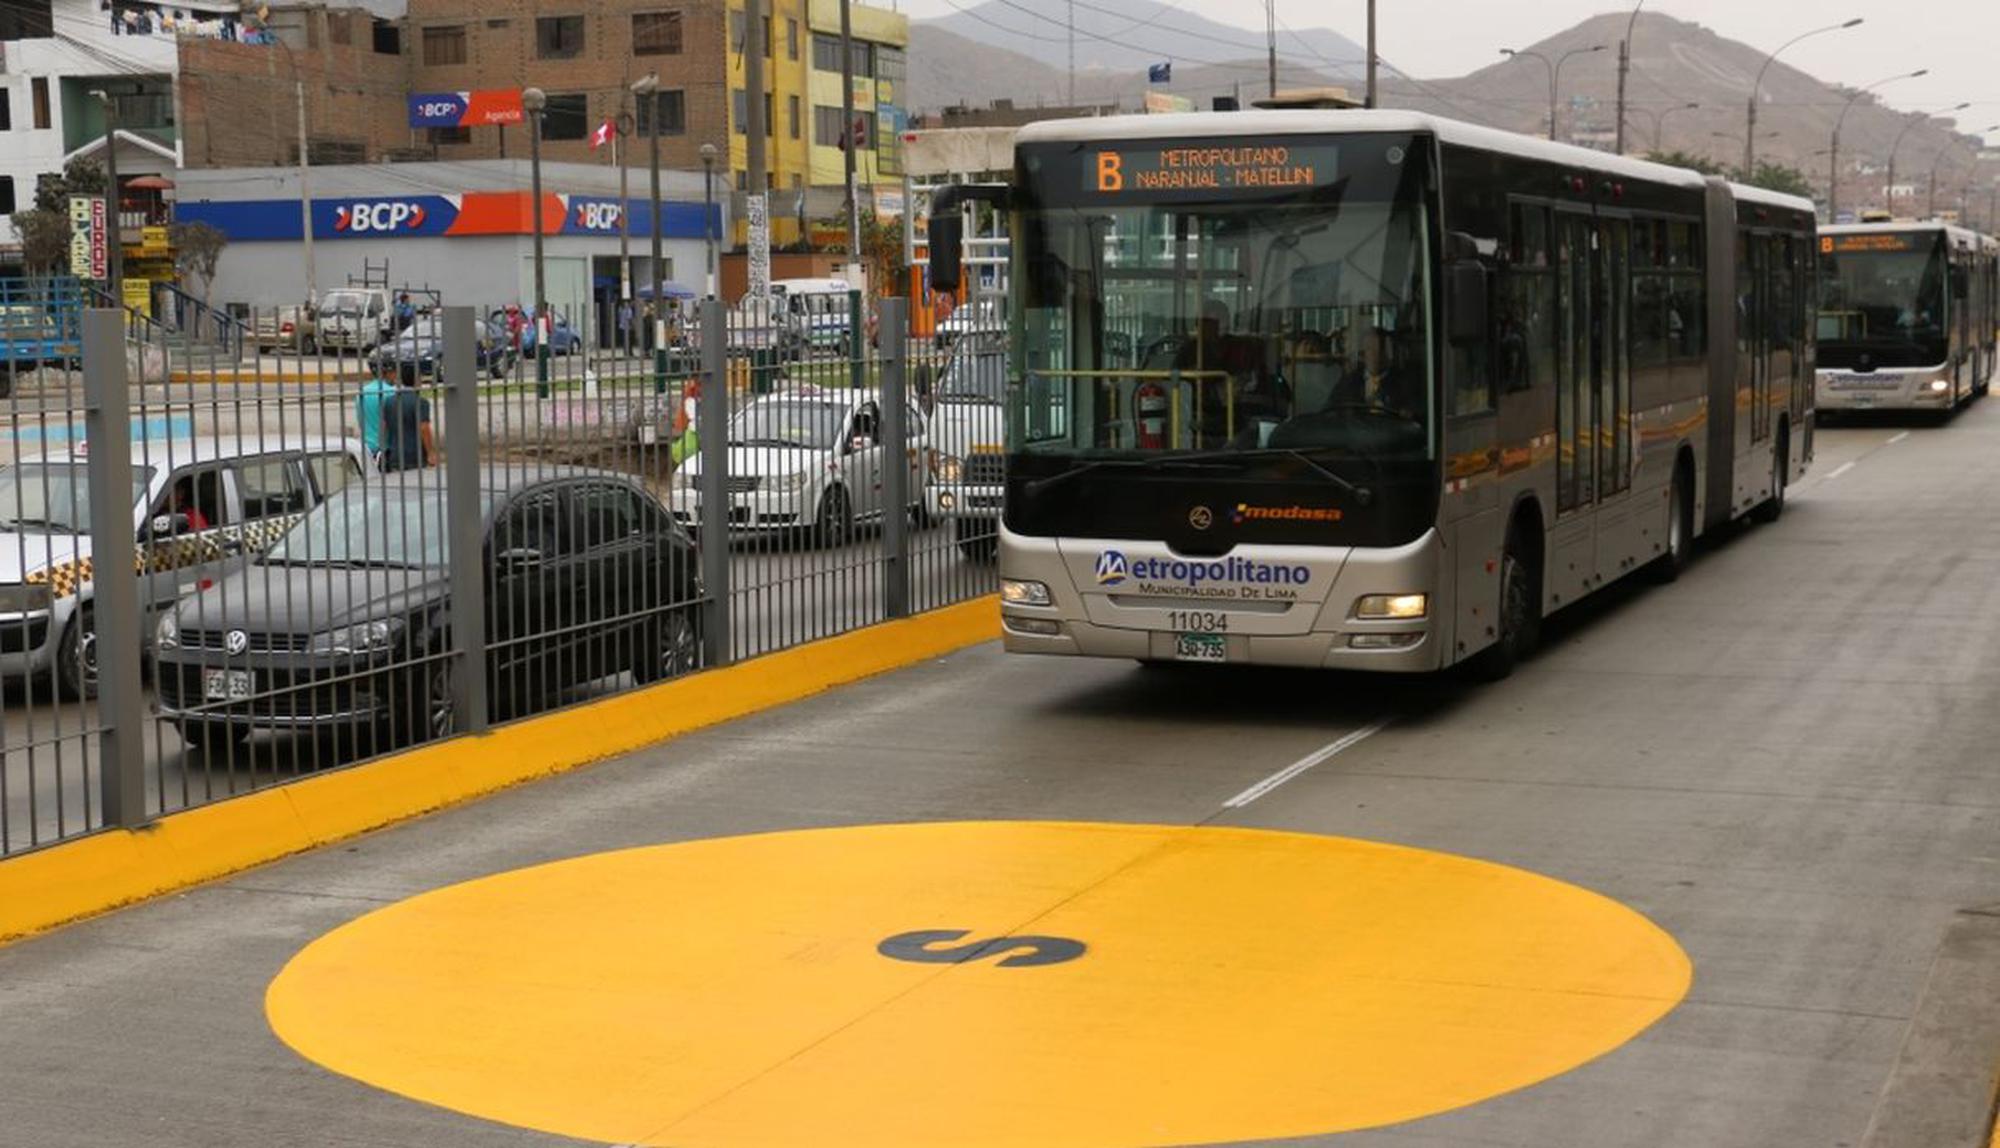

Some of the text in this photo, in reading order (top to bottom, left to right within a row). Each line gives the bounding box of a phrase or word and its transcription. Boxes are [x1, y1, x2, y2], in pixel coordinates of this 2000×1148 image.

[425, 103, 451, 117] BCP
[1161, 147, 1288, 167] METROPOLITANO
[1098, 152, 1122, 191] B
[1136, 169, 1220, 188] NARANJAL
[1236, 167, 1313, 186] MATELLINI
[351, 202, 409, 231] BCP
[586, 203, 618, 229] BCP
[92, 200, 106, 278] EUROS
[1822, 236, 1833, 253] B
[1245, 506, 1342, 520] modasa
[1265, 588, 1298, 599] LIMA
[1168, 611, 1228, 632] 11034
[877, 929, 1087, 967] S
